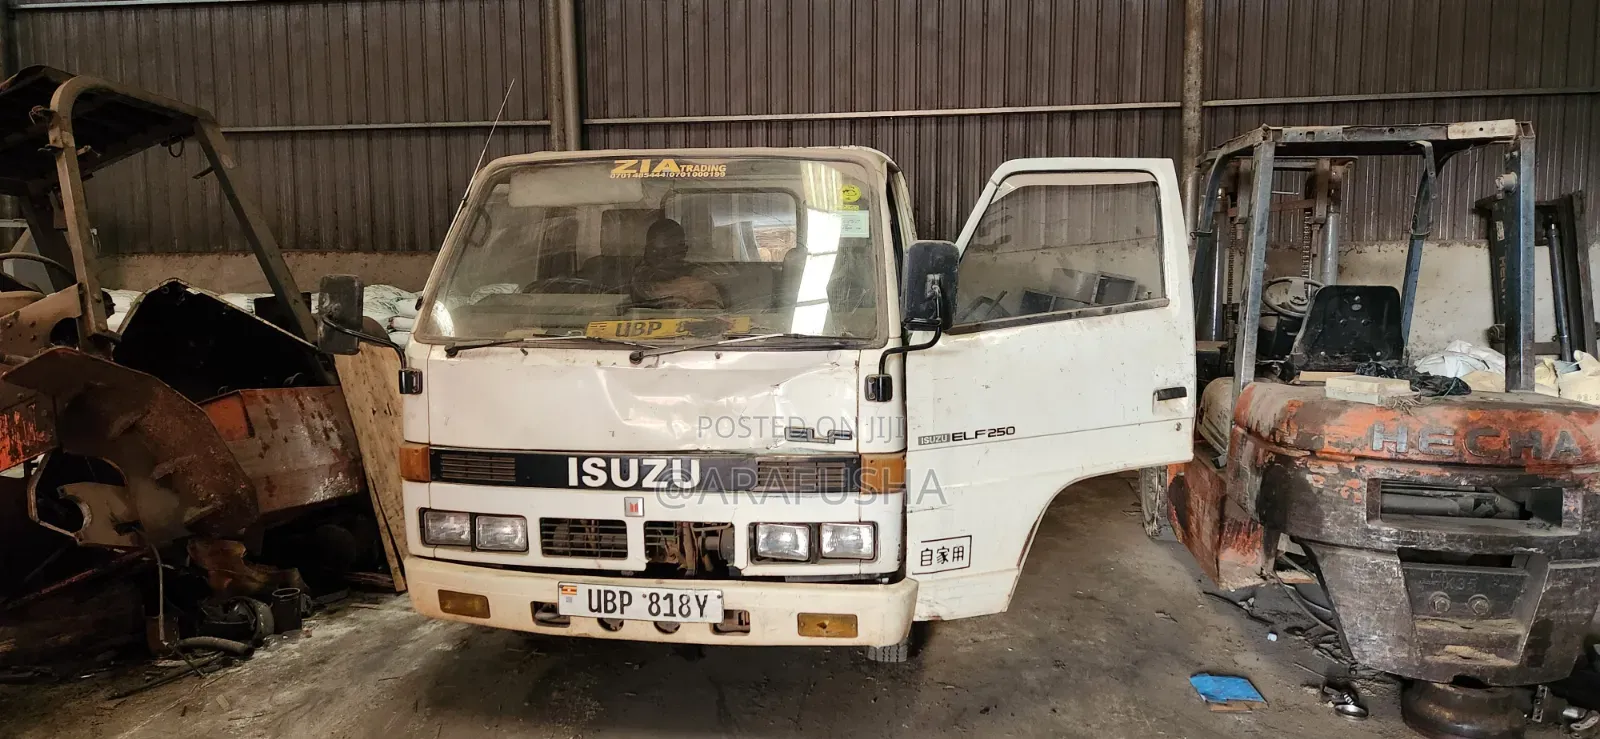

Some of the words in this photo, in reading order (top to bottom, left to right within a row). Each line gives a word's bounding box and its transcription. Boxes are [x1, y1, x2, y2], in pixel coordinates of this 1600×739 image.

[611, 158, 680, 173] ZIA
[680, 164, 726, 172] TRADING
[615, 321, 662, 337] UBP
[920, 434, 949, 445] ISUZU
[952, 430, 986, 442] ELF
[988, 426, 1016, 438] 250
[1371, 422, 1583, 460] HECHA
[568, 456, 700, 488] ISUZU
[920, 546, 964, 566] 自家用
[587, 588, 633, 614] UBP
[647, 592, 708, 618] 818Y
